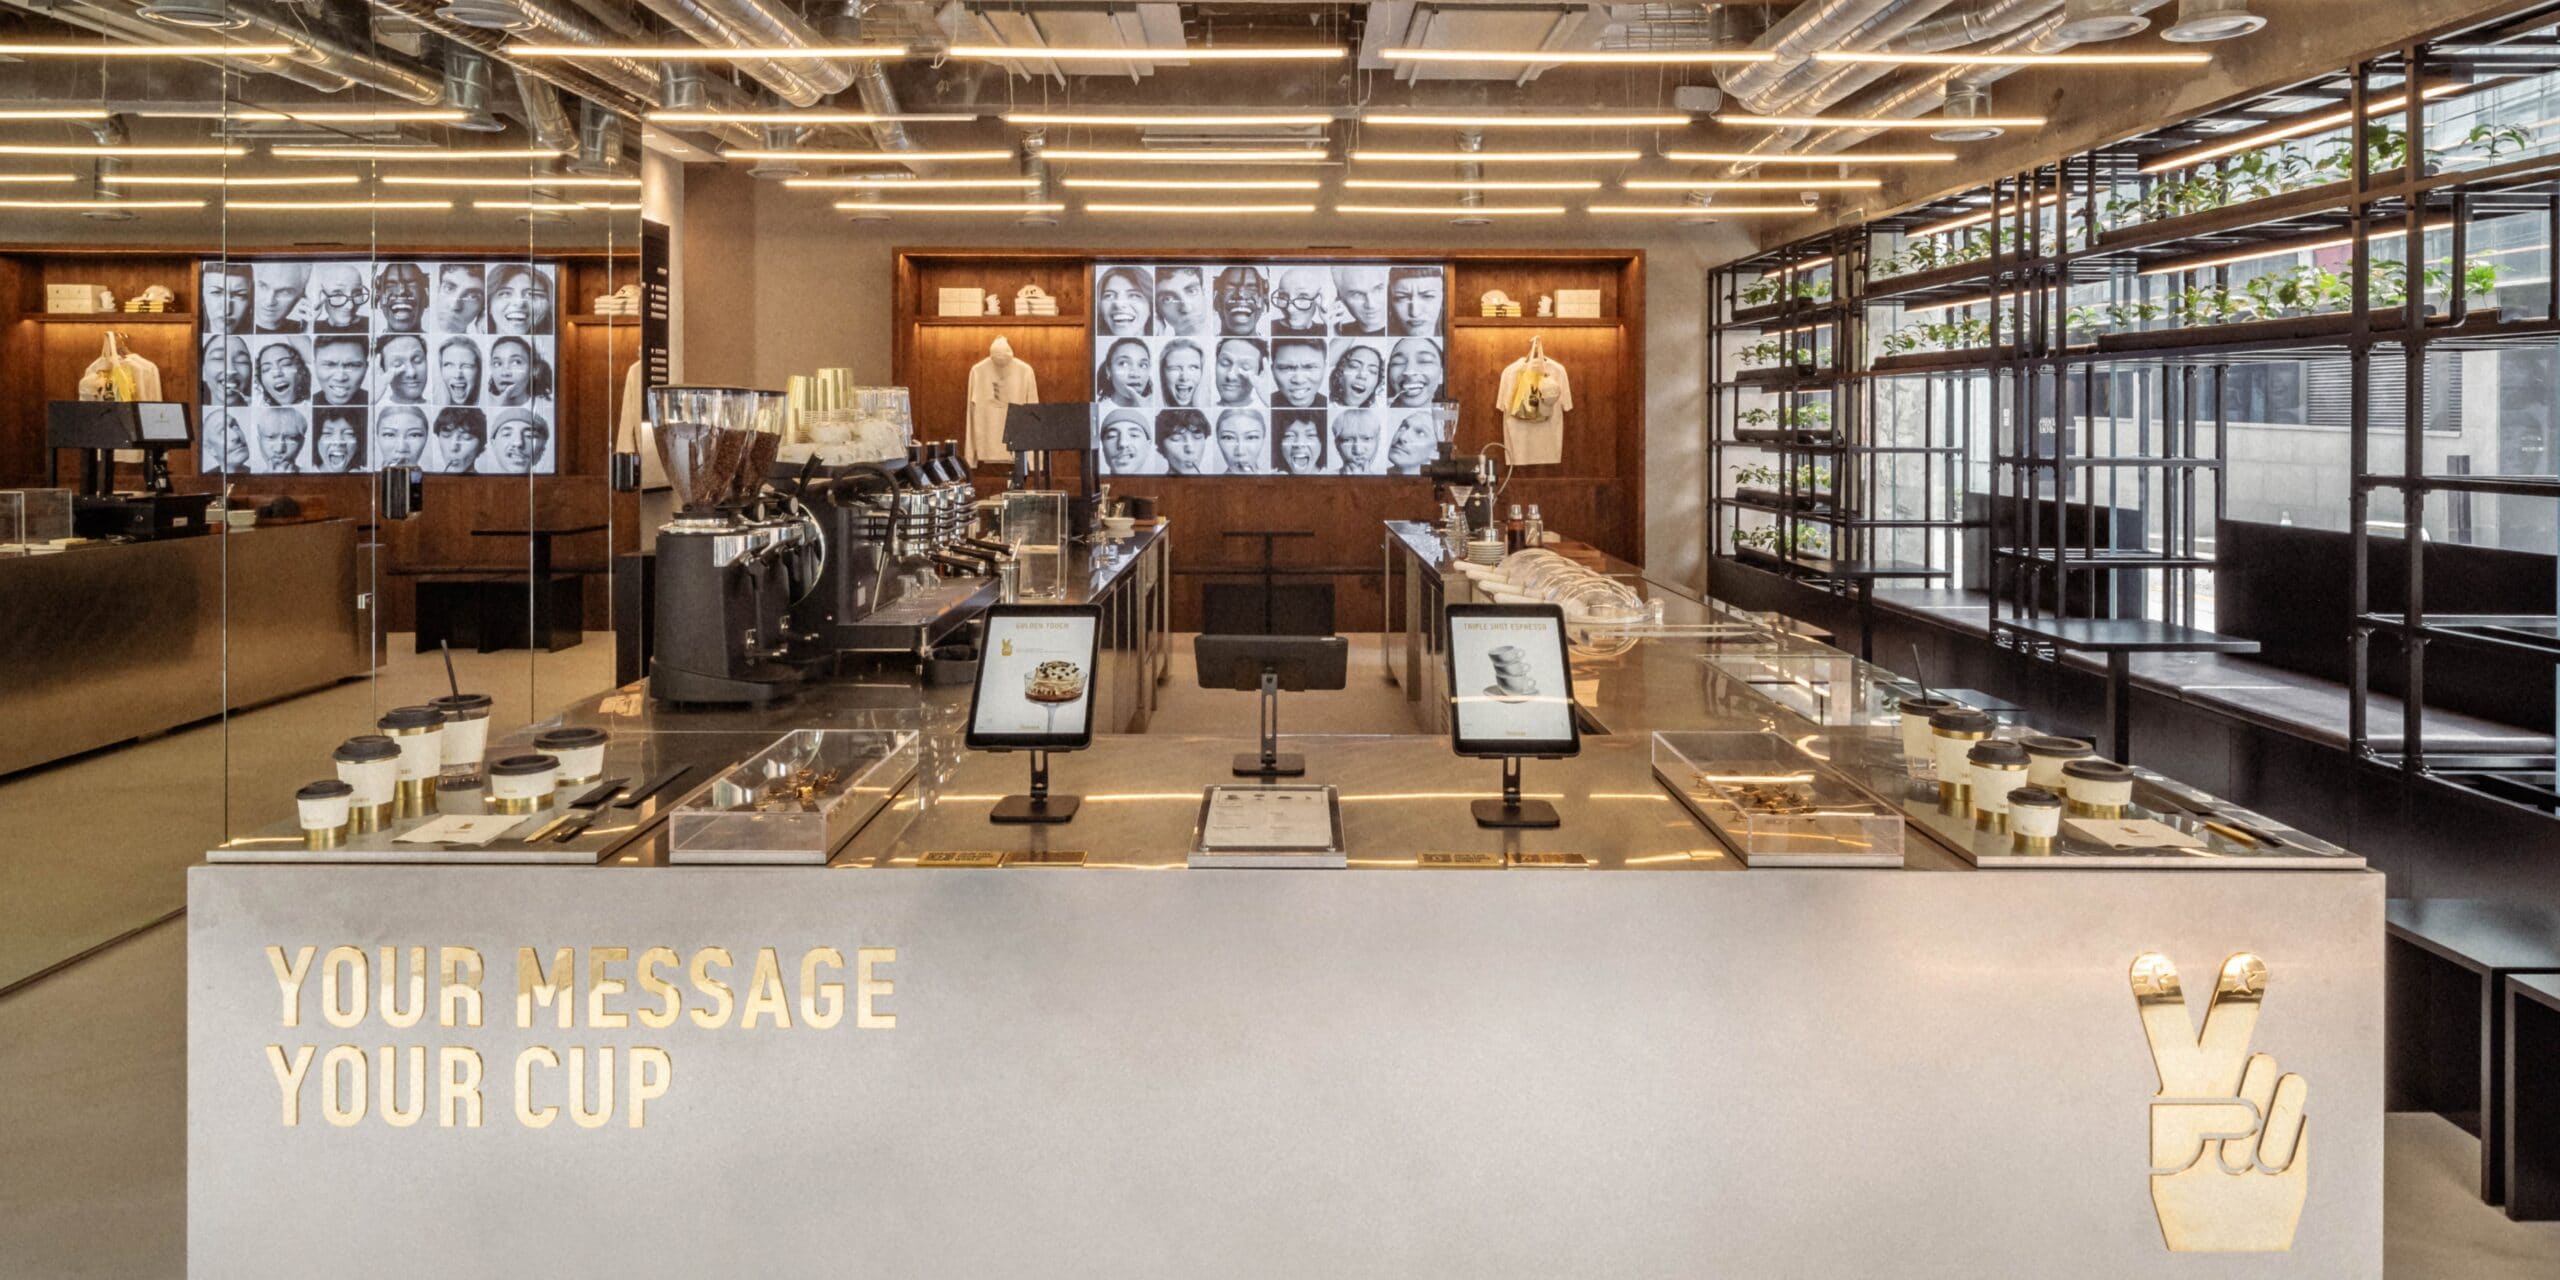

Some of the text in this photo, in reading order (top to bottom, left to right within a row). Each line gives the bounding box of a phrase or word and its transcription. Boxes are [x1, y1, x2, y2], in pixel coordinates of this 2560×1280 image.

[1463, 623, 1489, 631] TRIPLE
[1510, 623, 1548, 631] ESPRESSO
[266, 945, 897, 1030] YOUR MESSAGE
[265, 1045, 673, 1129] YOUR CUP
